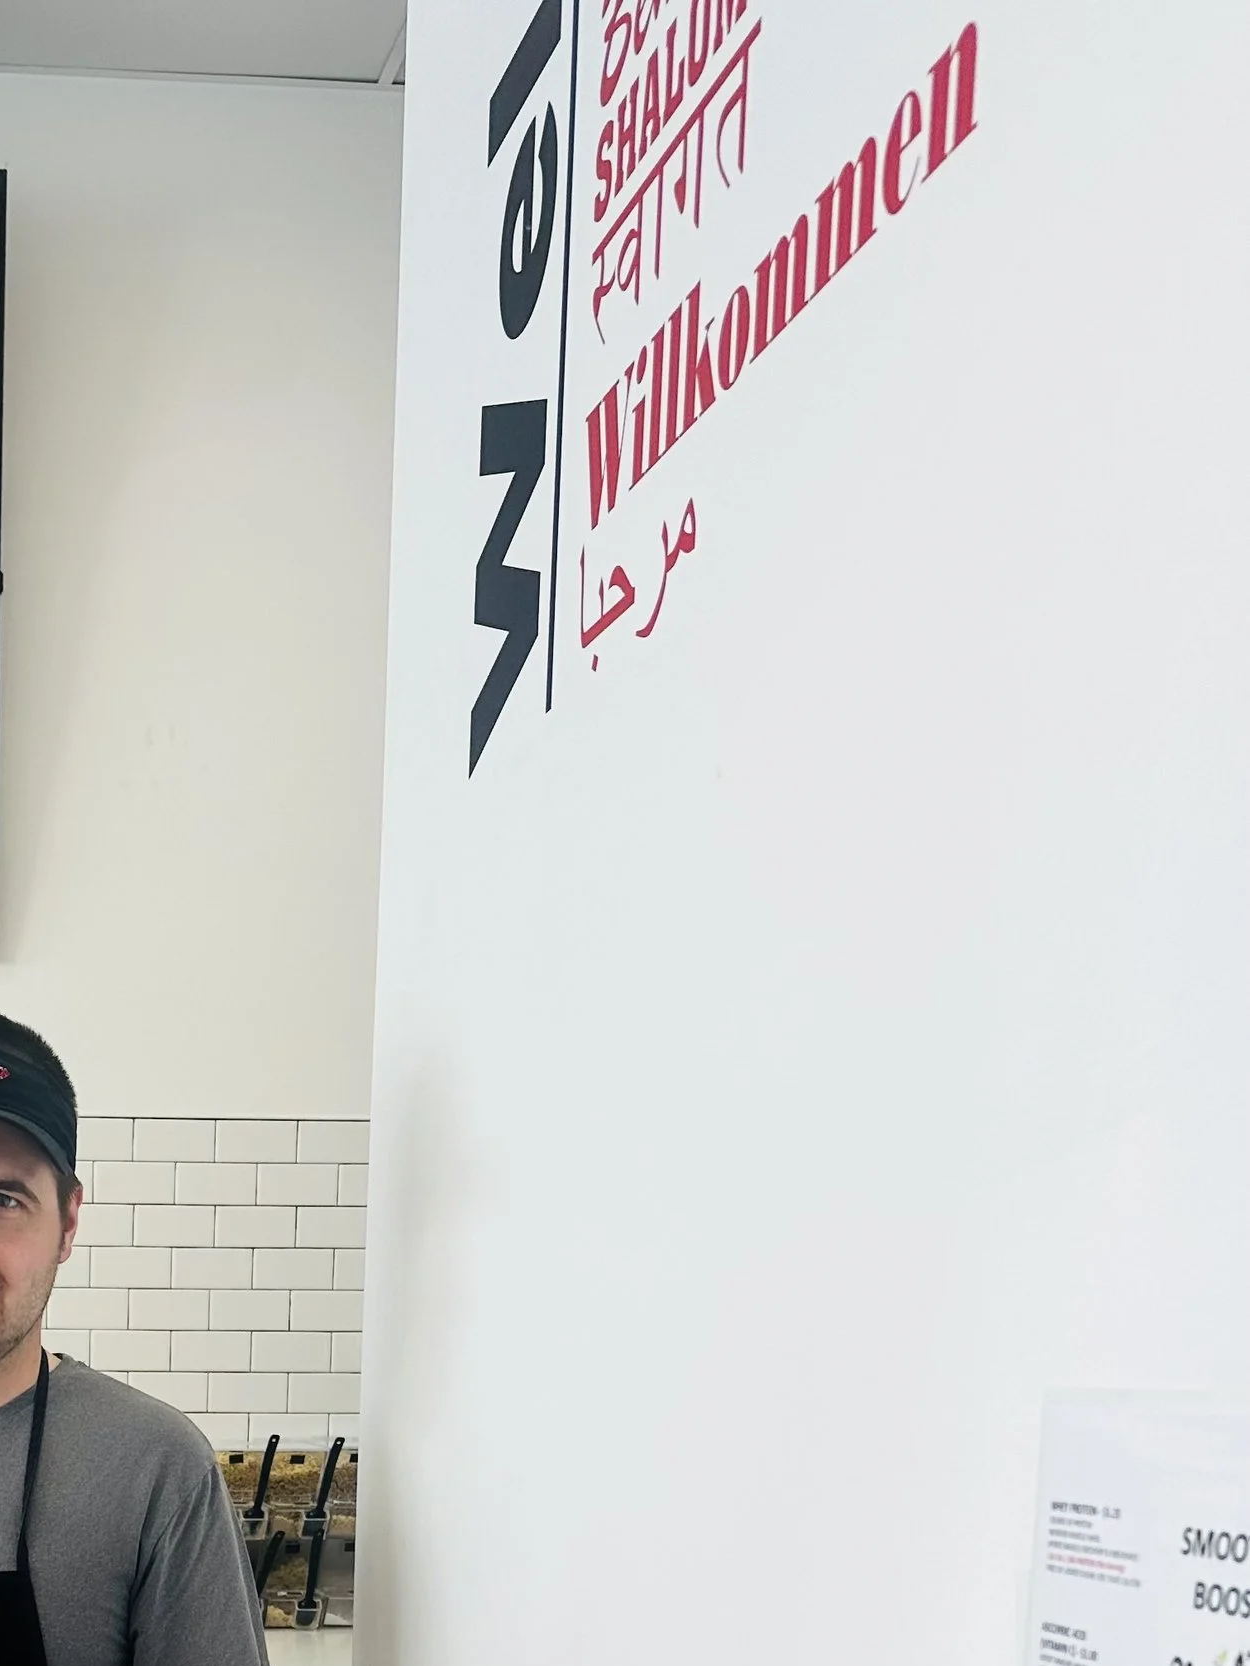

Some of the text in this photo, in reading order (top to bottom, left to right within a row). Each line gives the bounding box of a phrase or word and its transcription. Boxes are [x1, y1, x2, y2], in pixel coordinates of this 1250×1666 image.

[584, 20, 978, 530] Willkommen
[580, 497, 696, 672] مرحبا
[1181, 1526, 1250, 1563] SMOO
